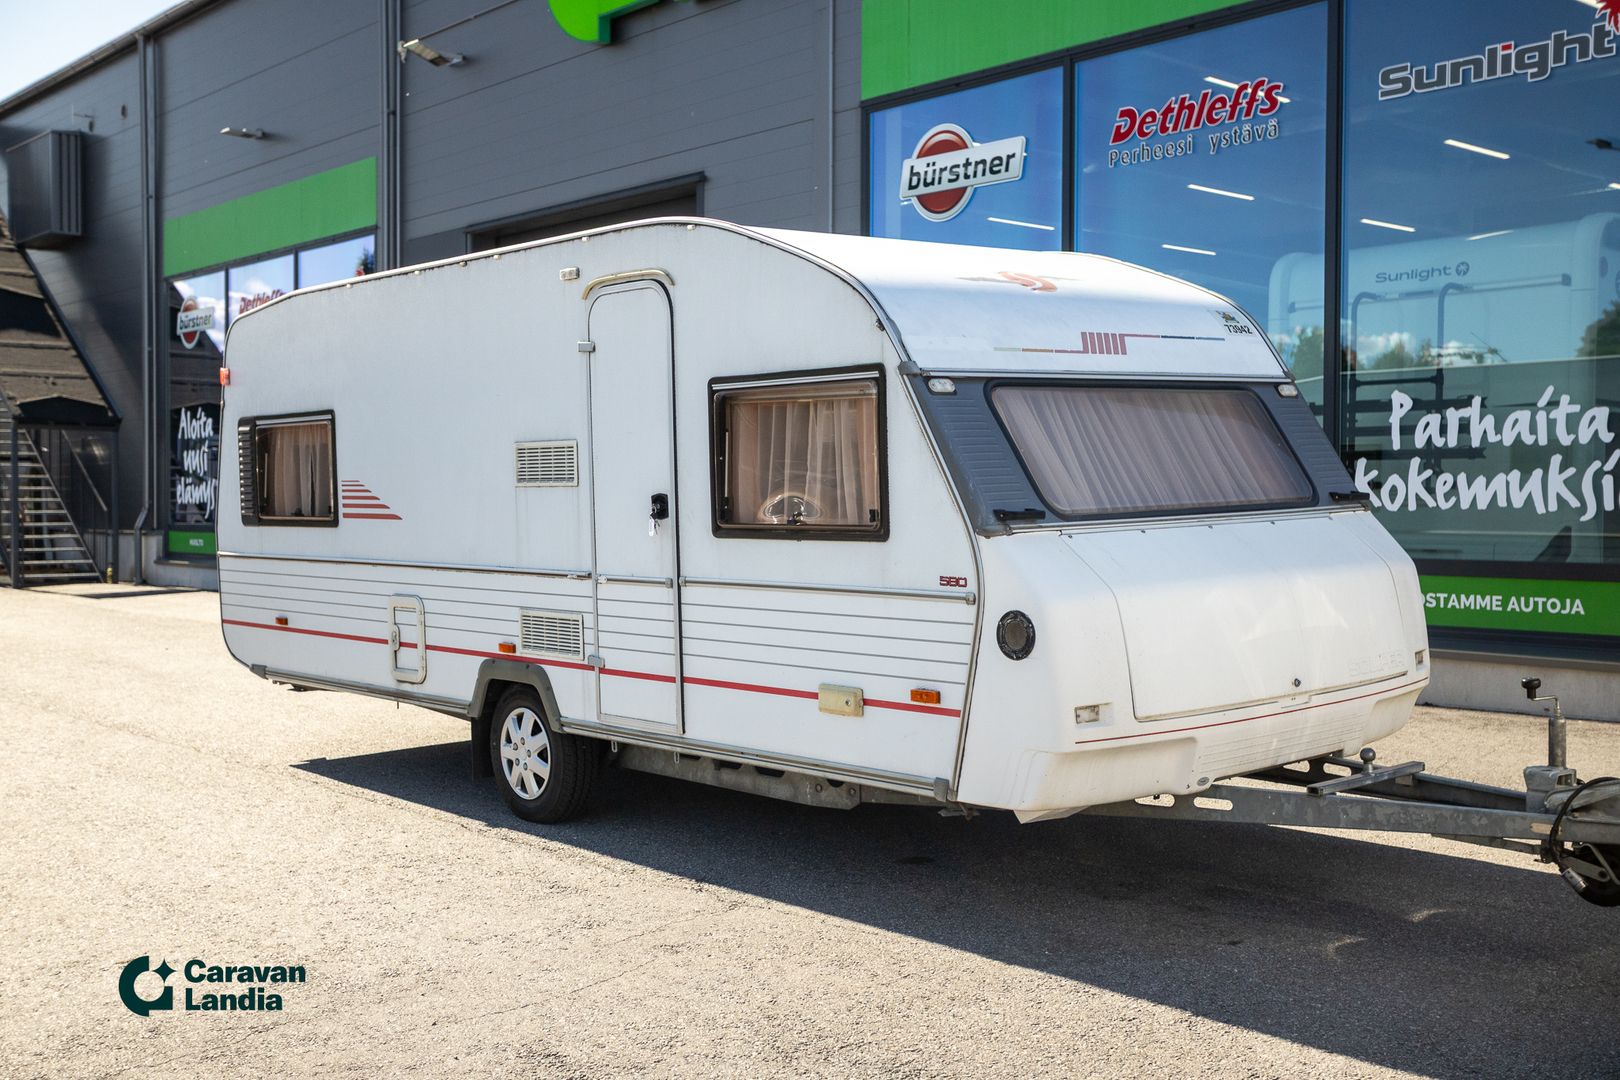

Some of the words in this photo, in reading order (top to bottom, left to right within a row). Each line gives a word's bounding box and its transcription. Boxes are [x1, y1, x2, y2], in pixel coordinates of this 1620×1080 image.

[1378, 22, 1616, 101] Sunlight
[1110, 77, 1284, 146] Dethleffs
[1109, 133, 1193, 168] Perheesi
[1209, 117, 1280, 156] ystävä
[907, 149, 1017, 192] bürstner
[1375, 264, 1452, 284] Sunlight
[179, 313, 212, 331] bürstner
[178, 406, 214, 440] Aloita
[1388, 385, 1616, 451] Parhaita
[1354, 448, 1620, 522] kokemuksi
[939, 575, 968, 588] 580
[1506, 595, 1585, 616] AUTOJA
